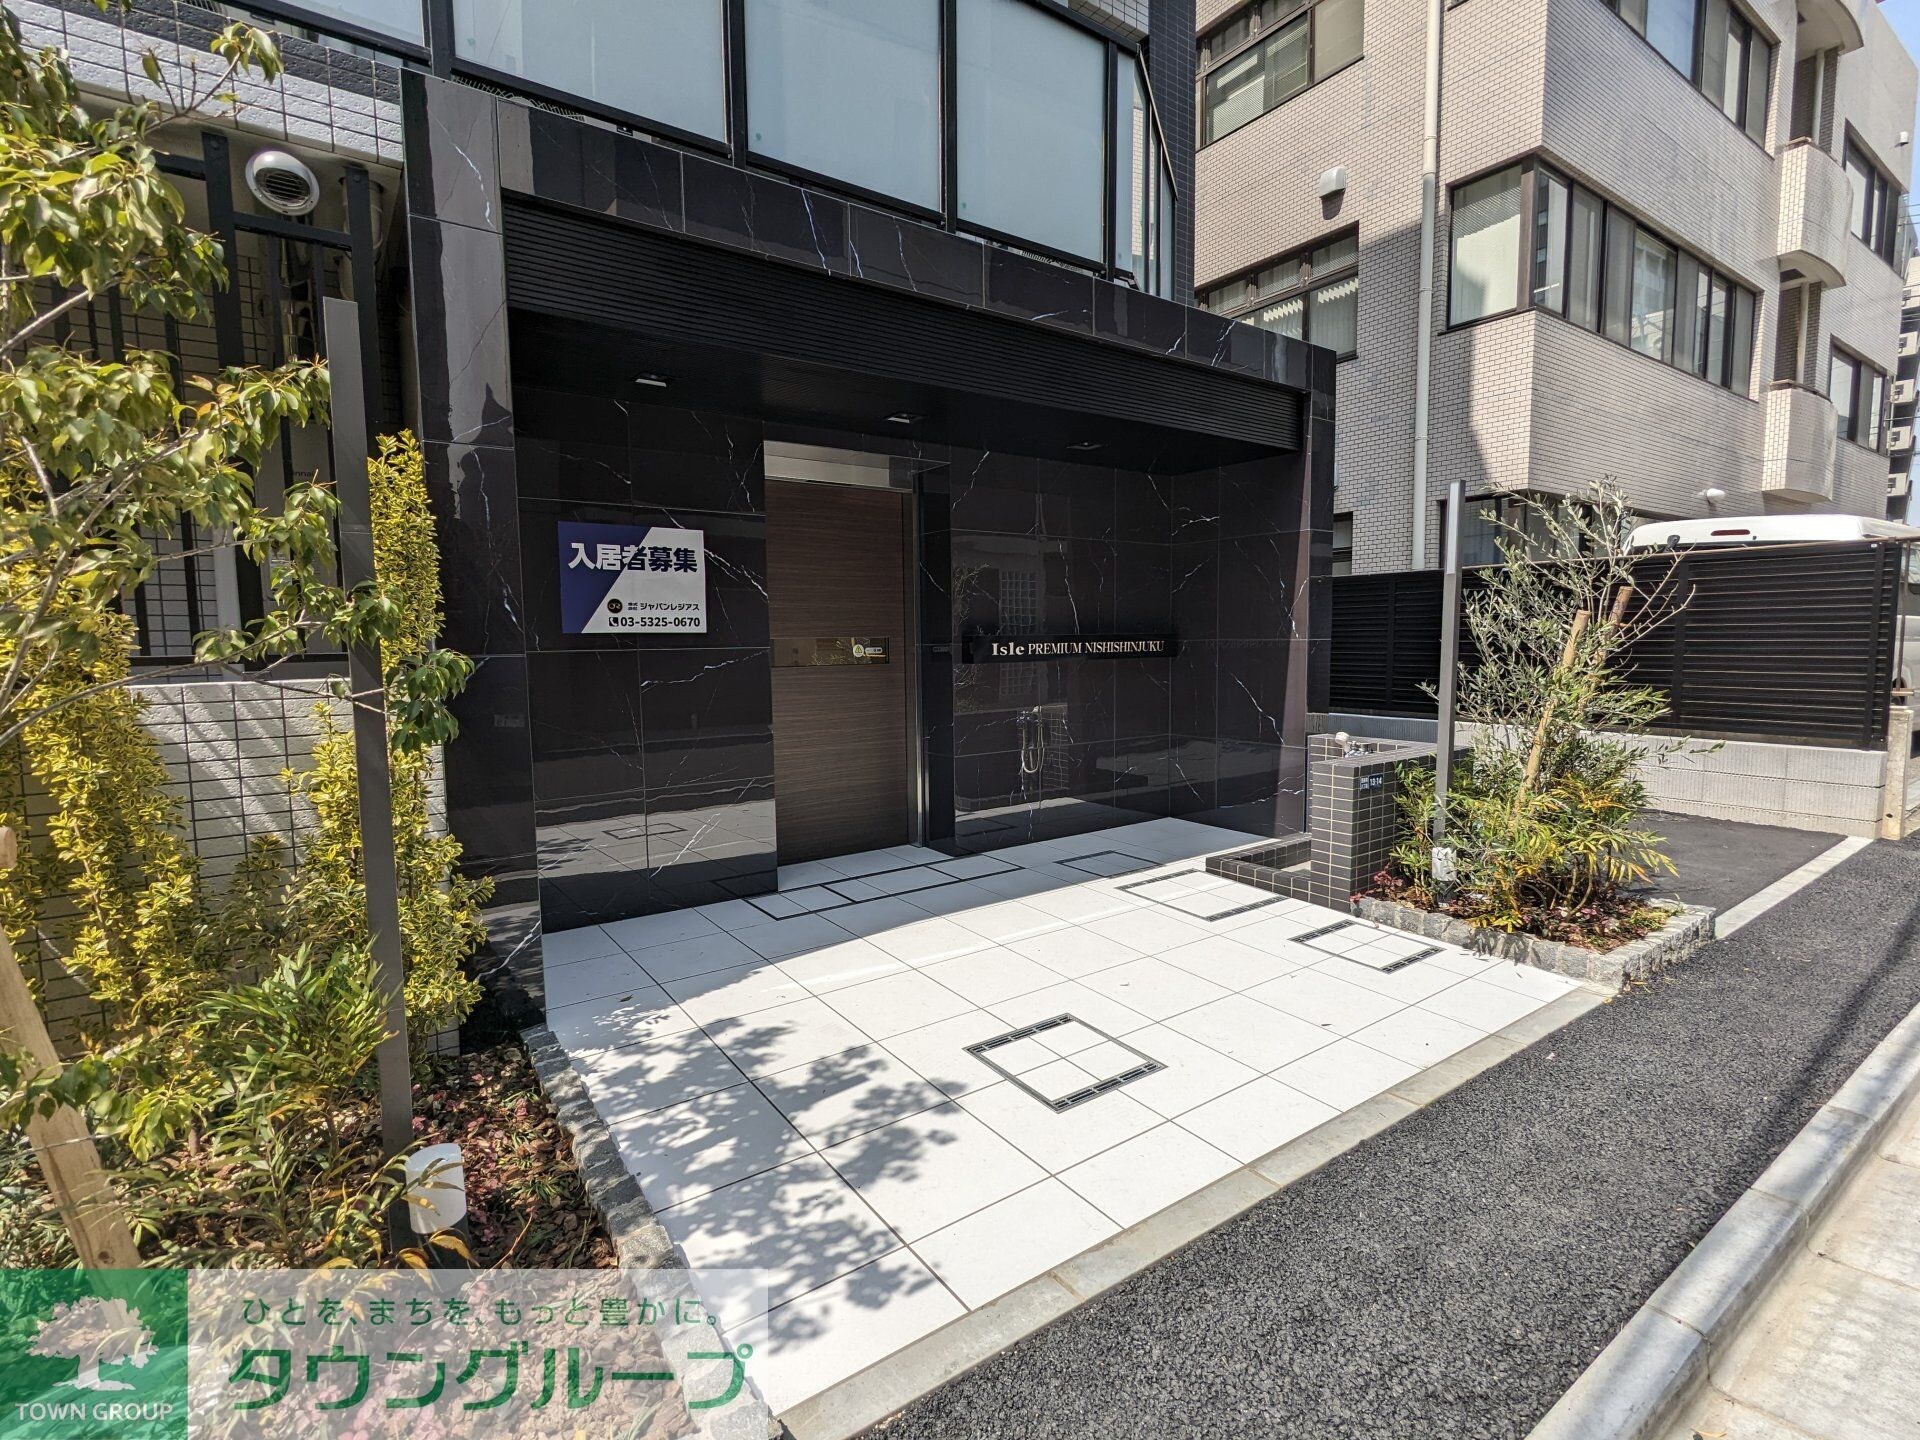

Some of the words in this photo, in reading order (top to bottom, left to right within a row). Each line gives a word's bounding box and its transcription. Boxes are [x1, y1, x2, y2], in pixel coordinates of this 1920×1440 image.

[568, 542, 698, 573] 入居者募集
[640, 602, 700, 611] ジャパンレジアス
[620, 616, 701, 627] 03-5325-0670
[991, 641, 1024, 656] Isle
[1028, 642, 1082, 655] PREMIUM
[1085, 640, 1164, 653] NISHISHINJUKU
